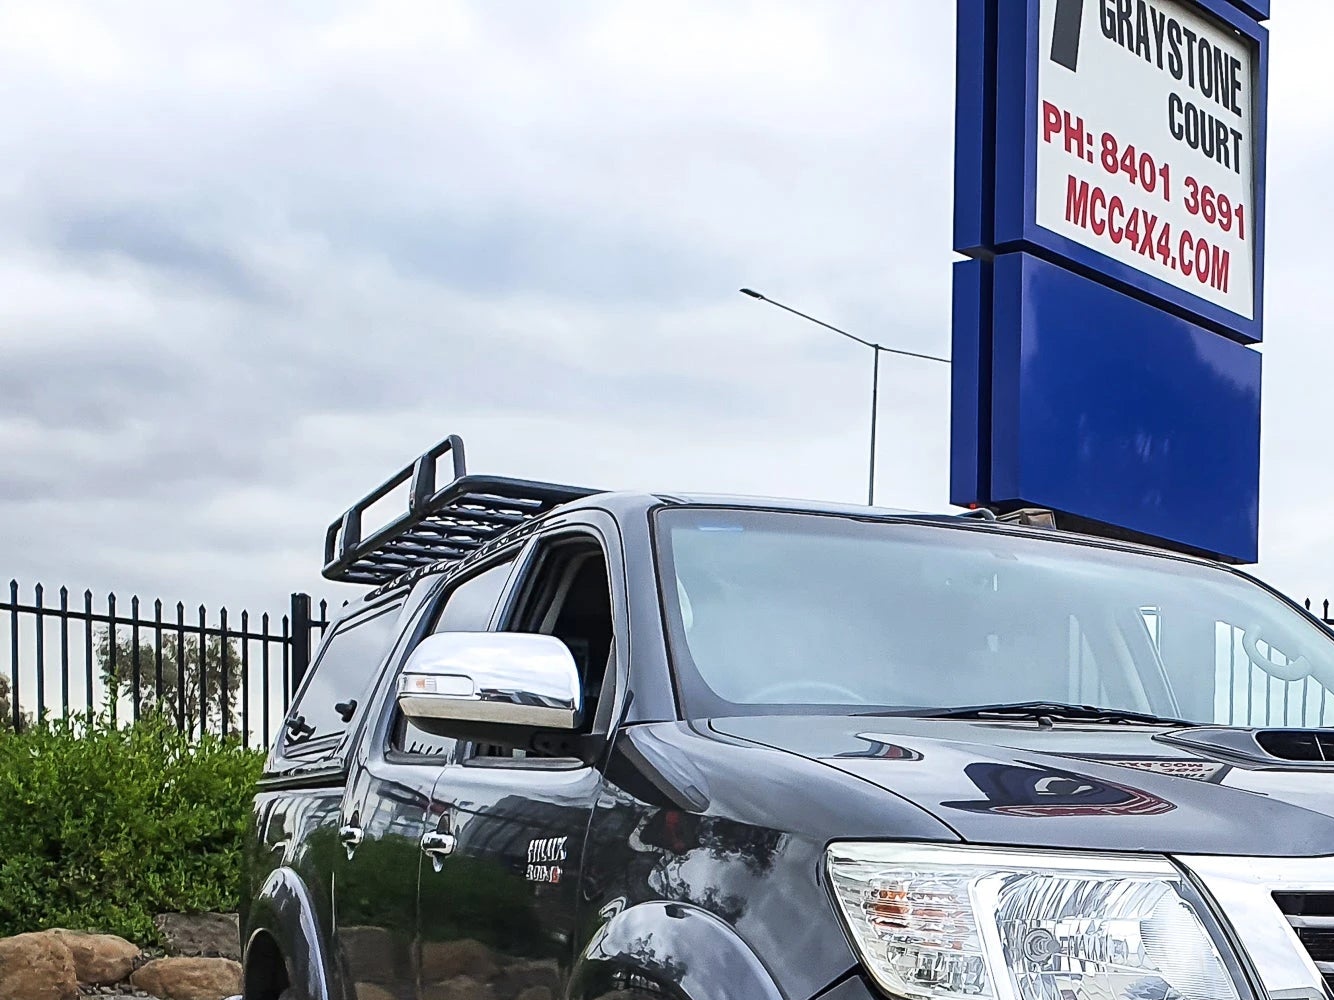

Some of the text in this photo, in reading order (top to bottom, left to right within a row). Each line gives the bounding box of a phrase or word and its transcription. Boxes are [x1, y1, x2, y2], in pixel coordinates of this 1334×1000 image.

[1100, 0, 1242, 118] GRAYSTONE
[1042, 99, 1245, 241] PH: 8401 3691
[1168, 92, 1243, 175] COURT
[1065, 174, 1230, 294] MCC4X4.COM
